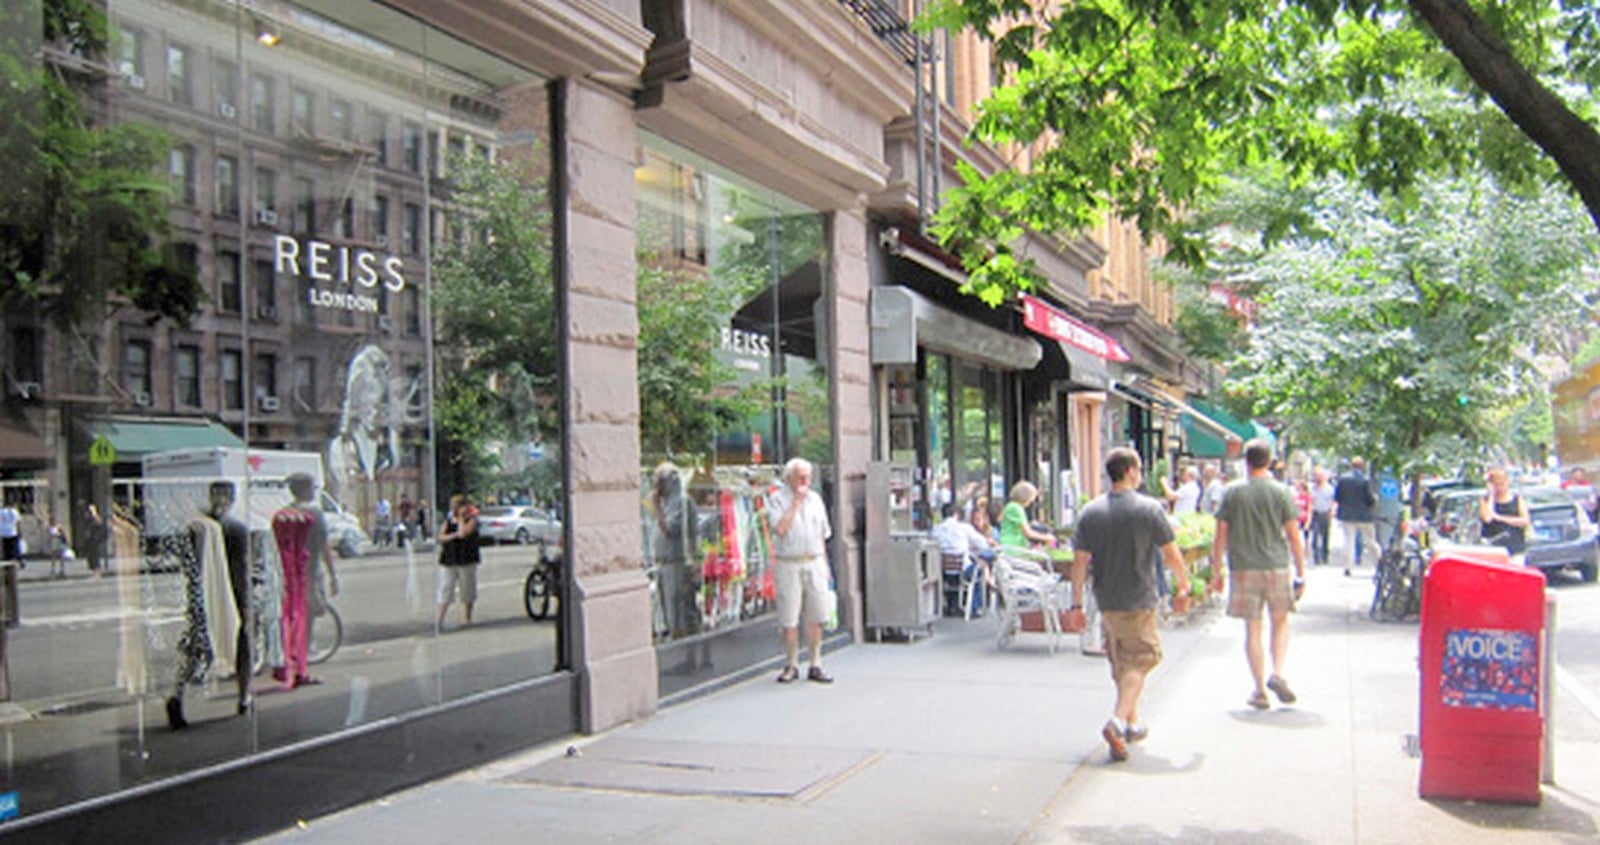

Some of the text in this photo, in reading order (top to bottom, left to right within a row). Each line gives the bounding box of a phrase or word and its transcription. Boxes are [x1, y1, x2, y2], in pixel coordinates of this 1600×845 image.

[274, 235, 405, 292] REISS
[310, 288, 379, 312] LONDON
[720, 328, 770, 358] REISS
[1452, 635, 1522, 661] VOICE
